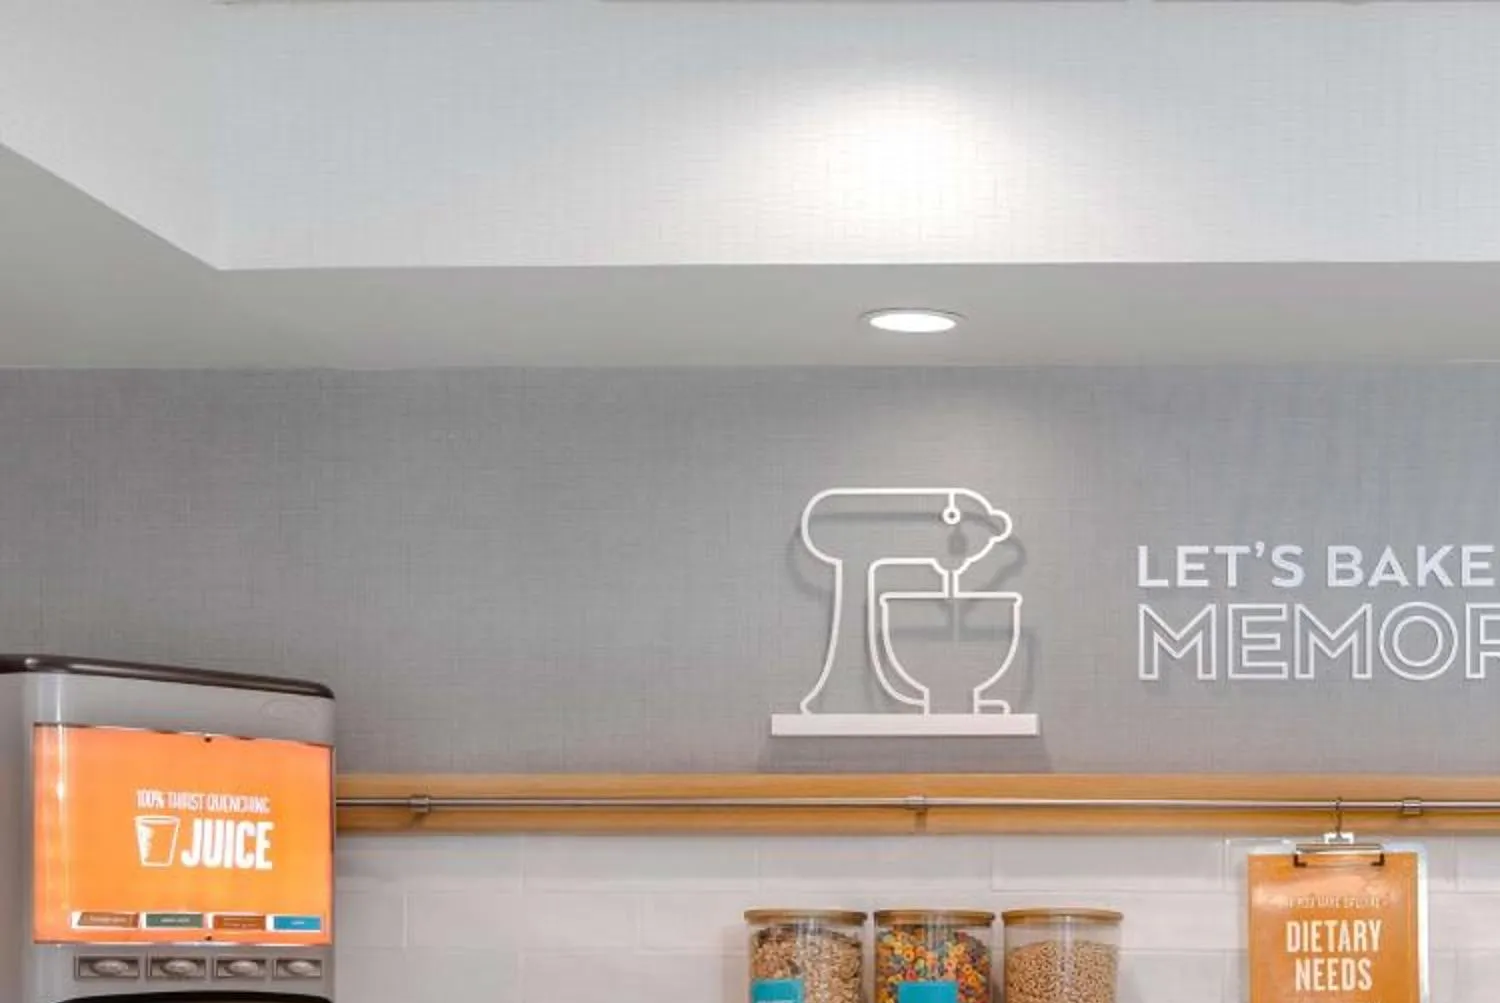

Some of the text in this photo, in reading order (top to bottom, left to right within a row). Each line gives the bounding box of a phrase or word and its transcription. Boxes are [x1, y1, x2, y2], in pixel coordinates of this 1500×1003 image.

[1138, 543, 1303, 588] LET'S
[1327, 544, 1495, 588] BAKE
[137, 790, 164, 808] 100%
[181, 818, 275, 870] JUICE
[1286, 919, 1383, 954] DIETARY
[1295, 958, 1373, 992] NEEDS
